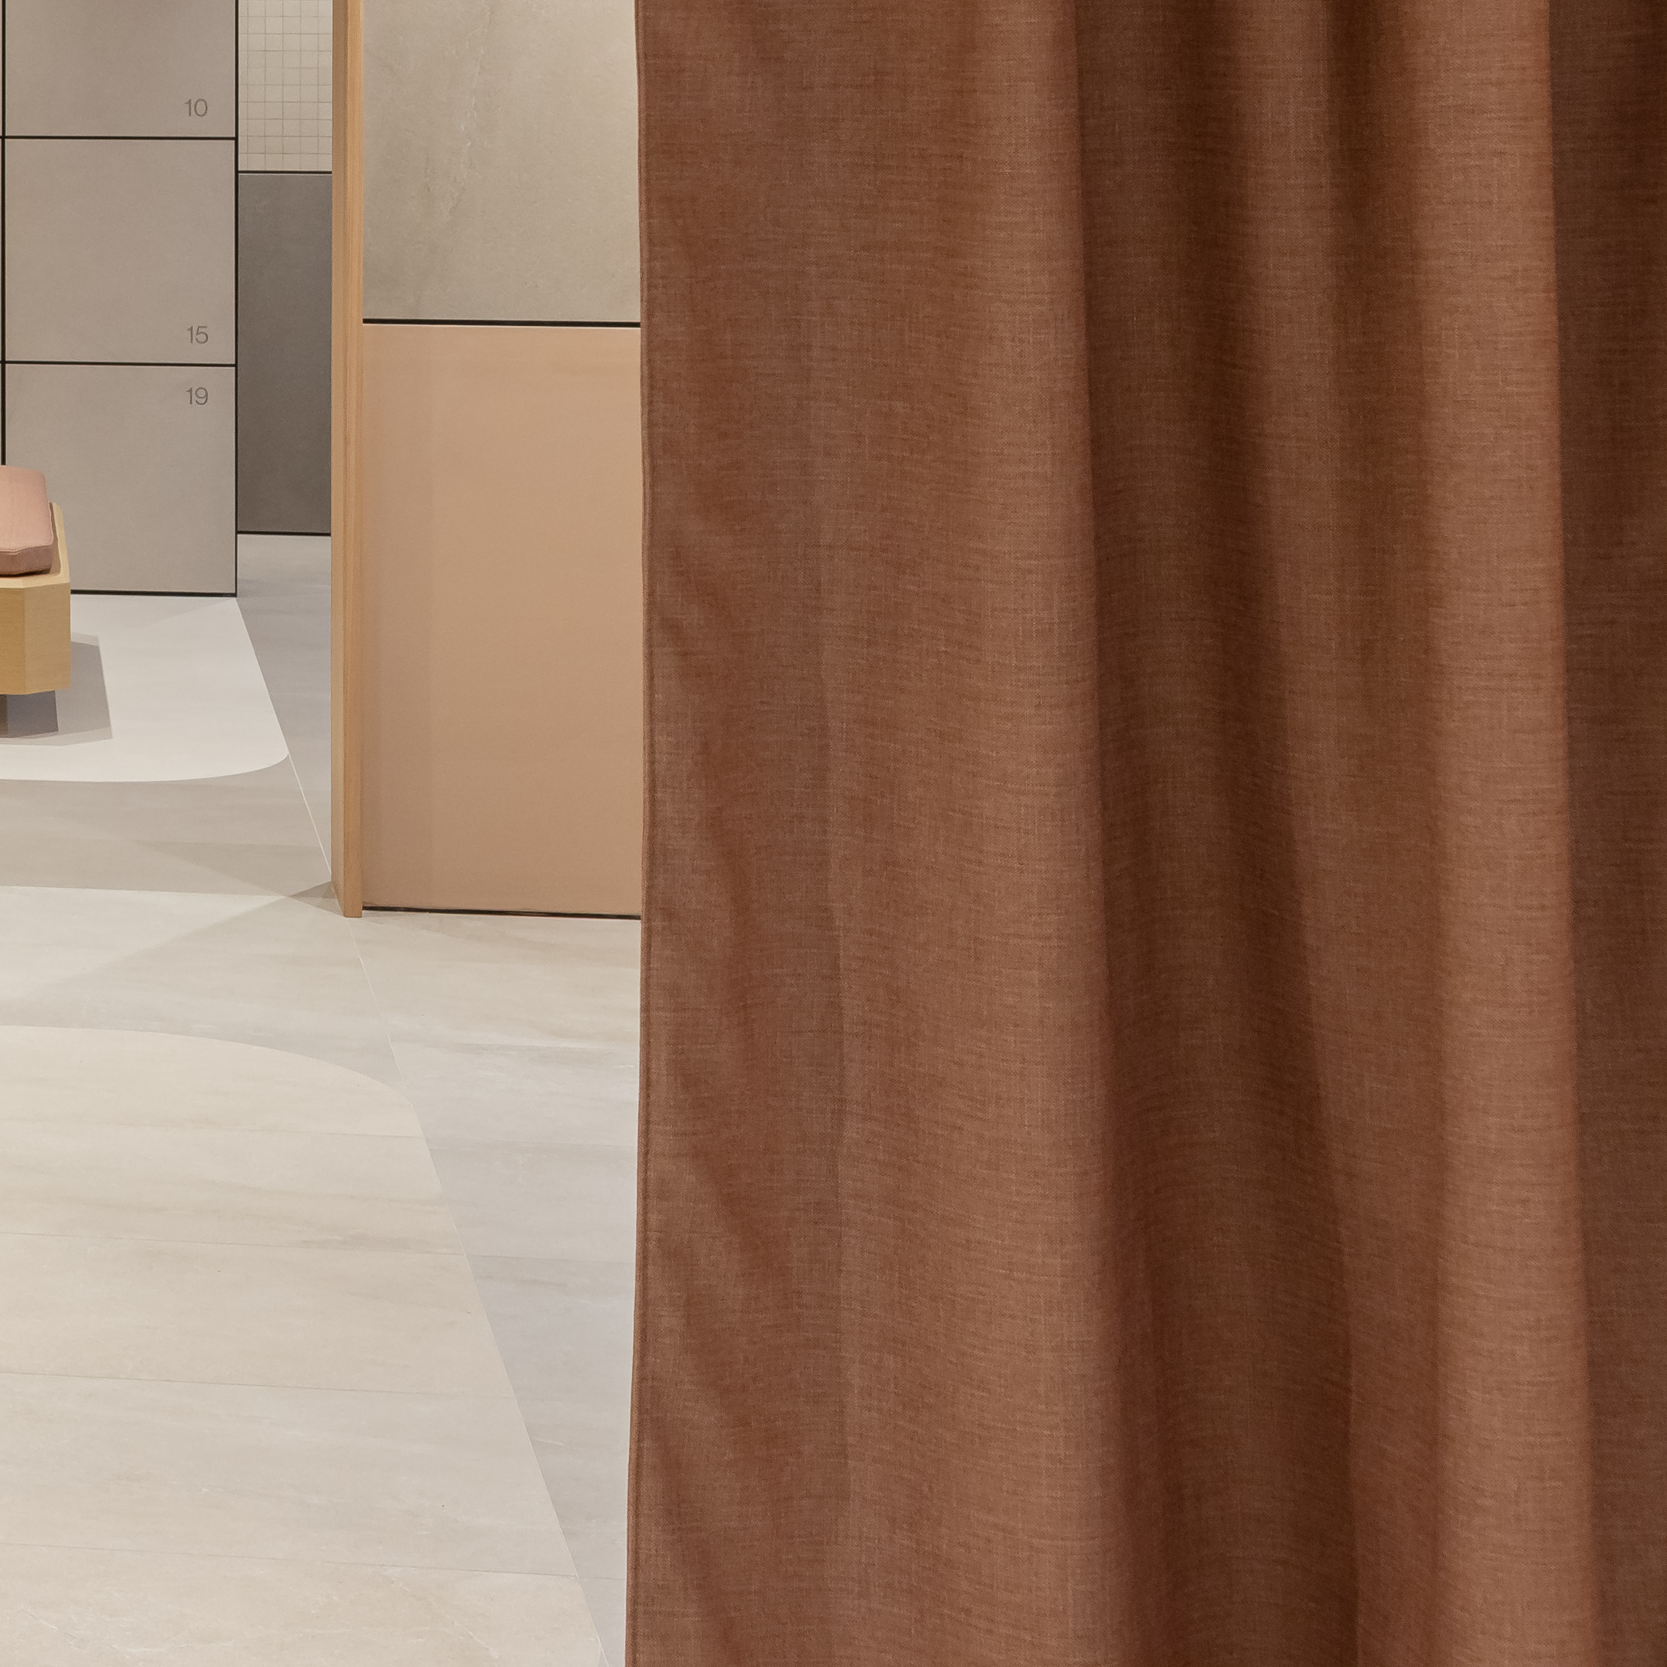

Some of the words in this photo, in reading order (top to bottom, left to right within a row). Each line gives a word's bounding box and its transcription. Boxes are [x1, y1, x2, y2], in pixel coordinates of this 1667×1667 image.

[184, 98, 209, 117] 10
[186, 325, 209, 344] 15
[186, 387, 209, 406] 19
